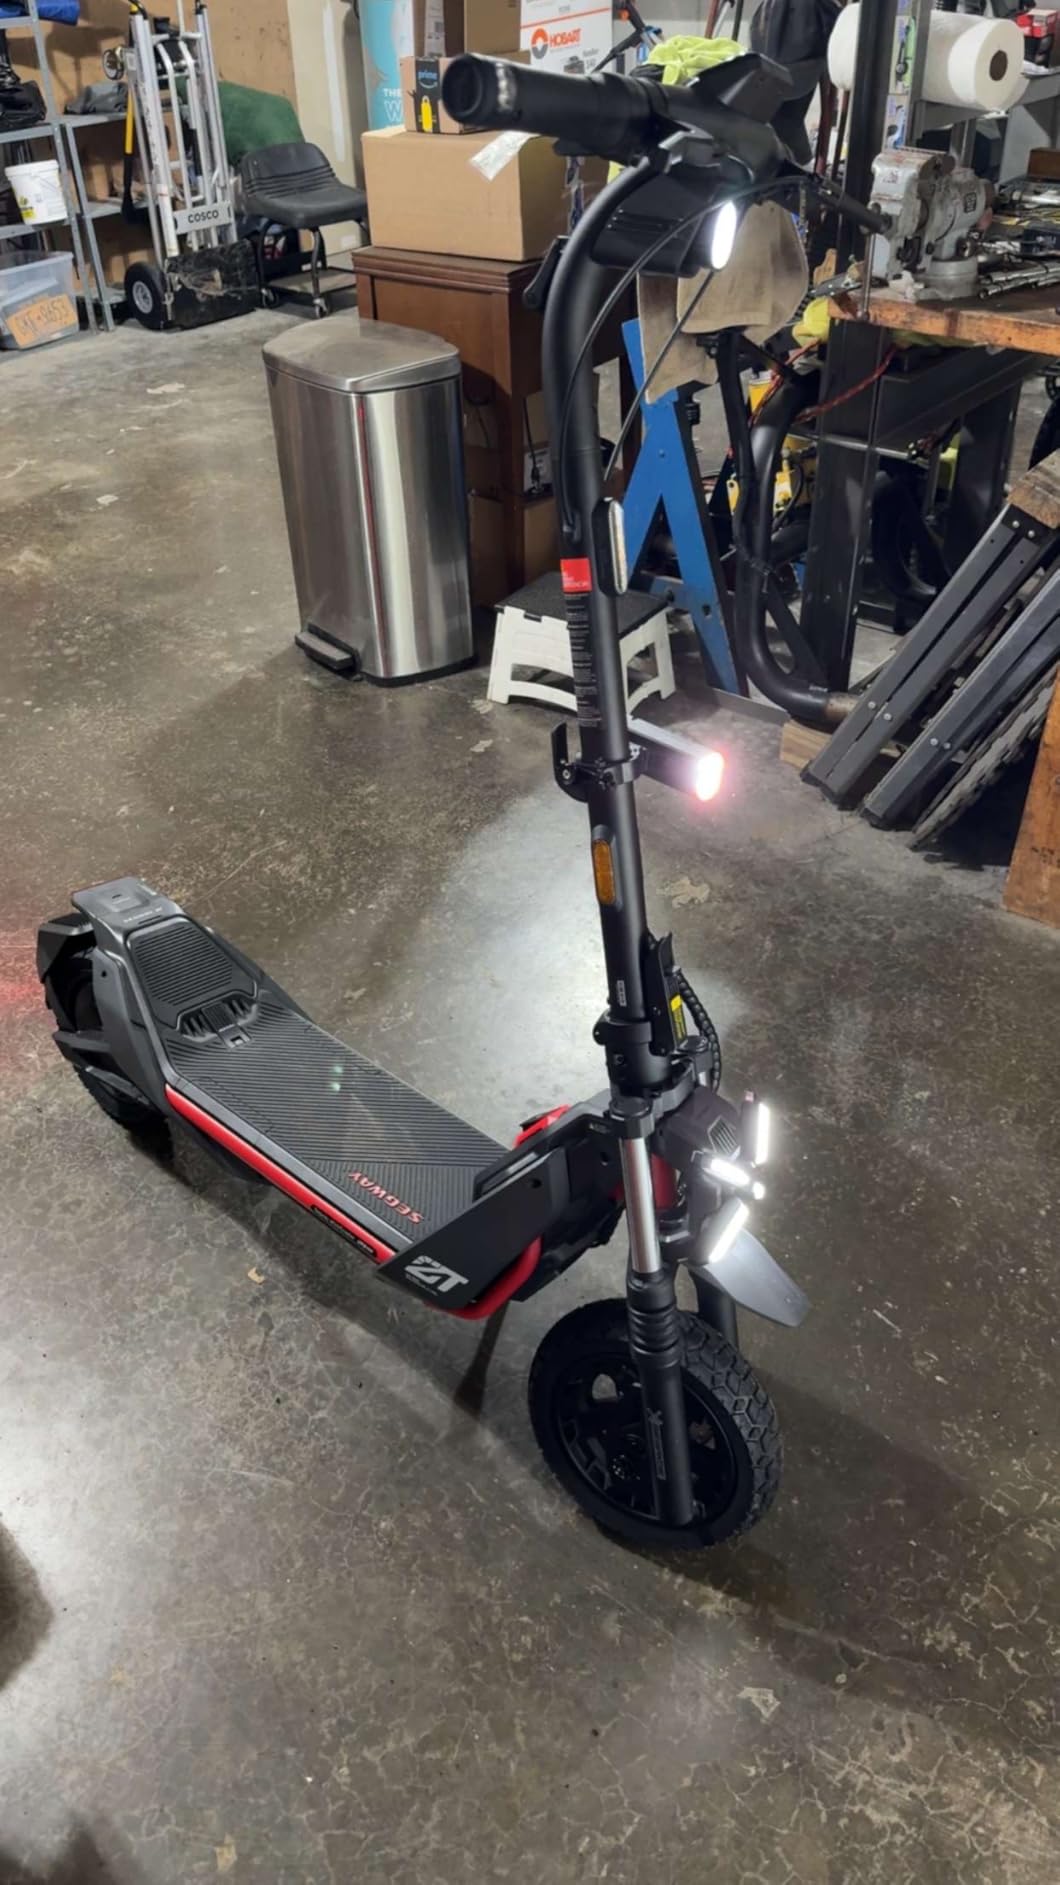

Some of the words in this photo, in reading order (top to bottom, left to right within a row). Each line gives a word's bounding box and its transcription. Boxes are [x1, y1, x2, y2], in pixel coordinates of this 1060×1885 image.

[550, 28, 581, 47] HOBART
[187, 210, 219, 224] COSCO
[347, 1171, 424, 1224] SEGWAY
